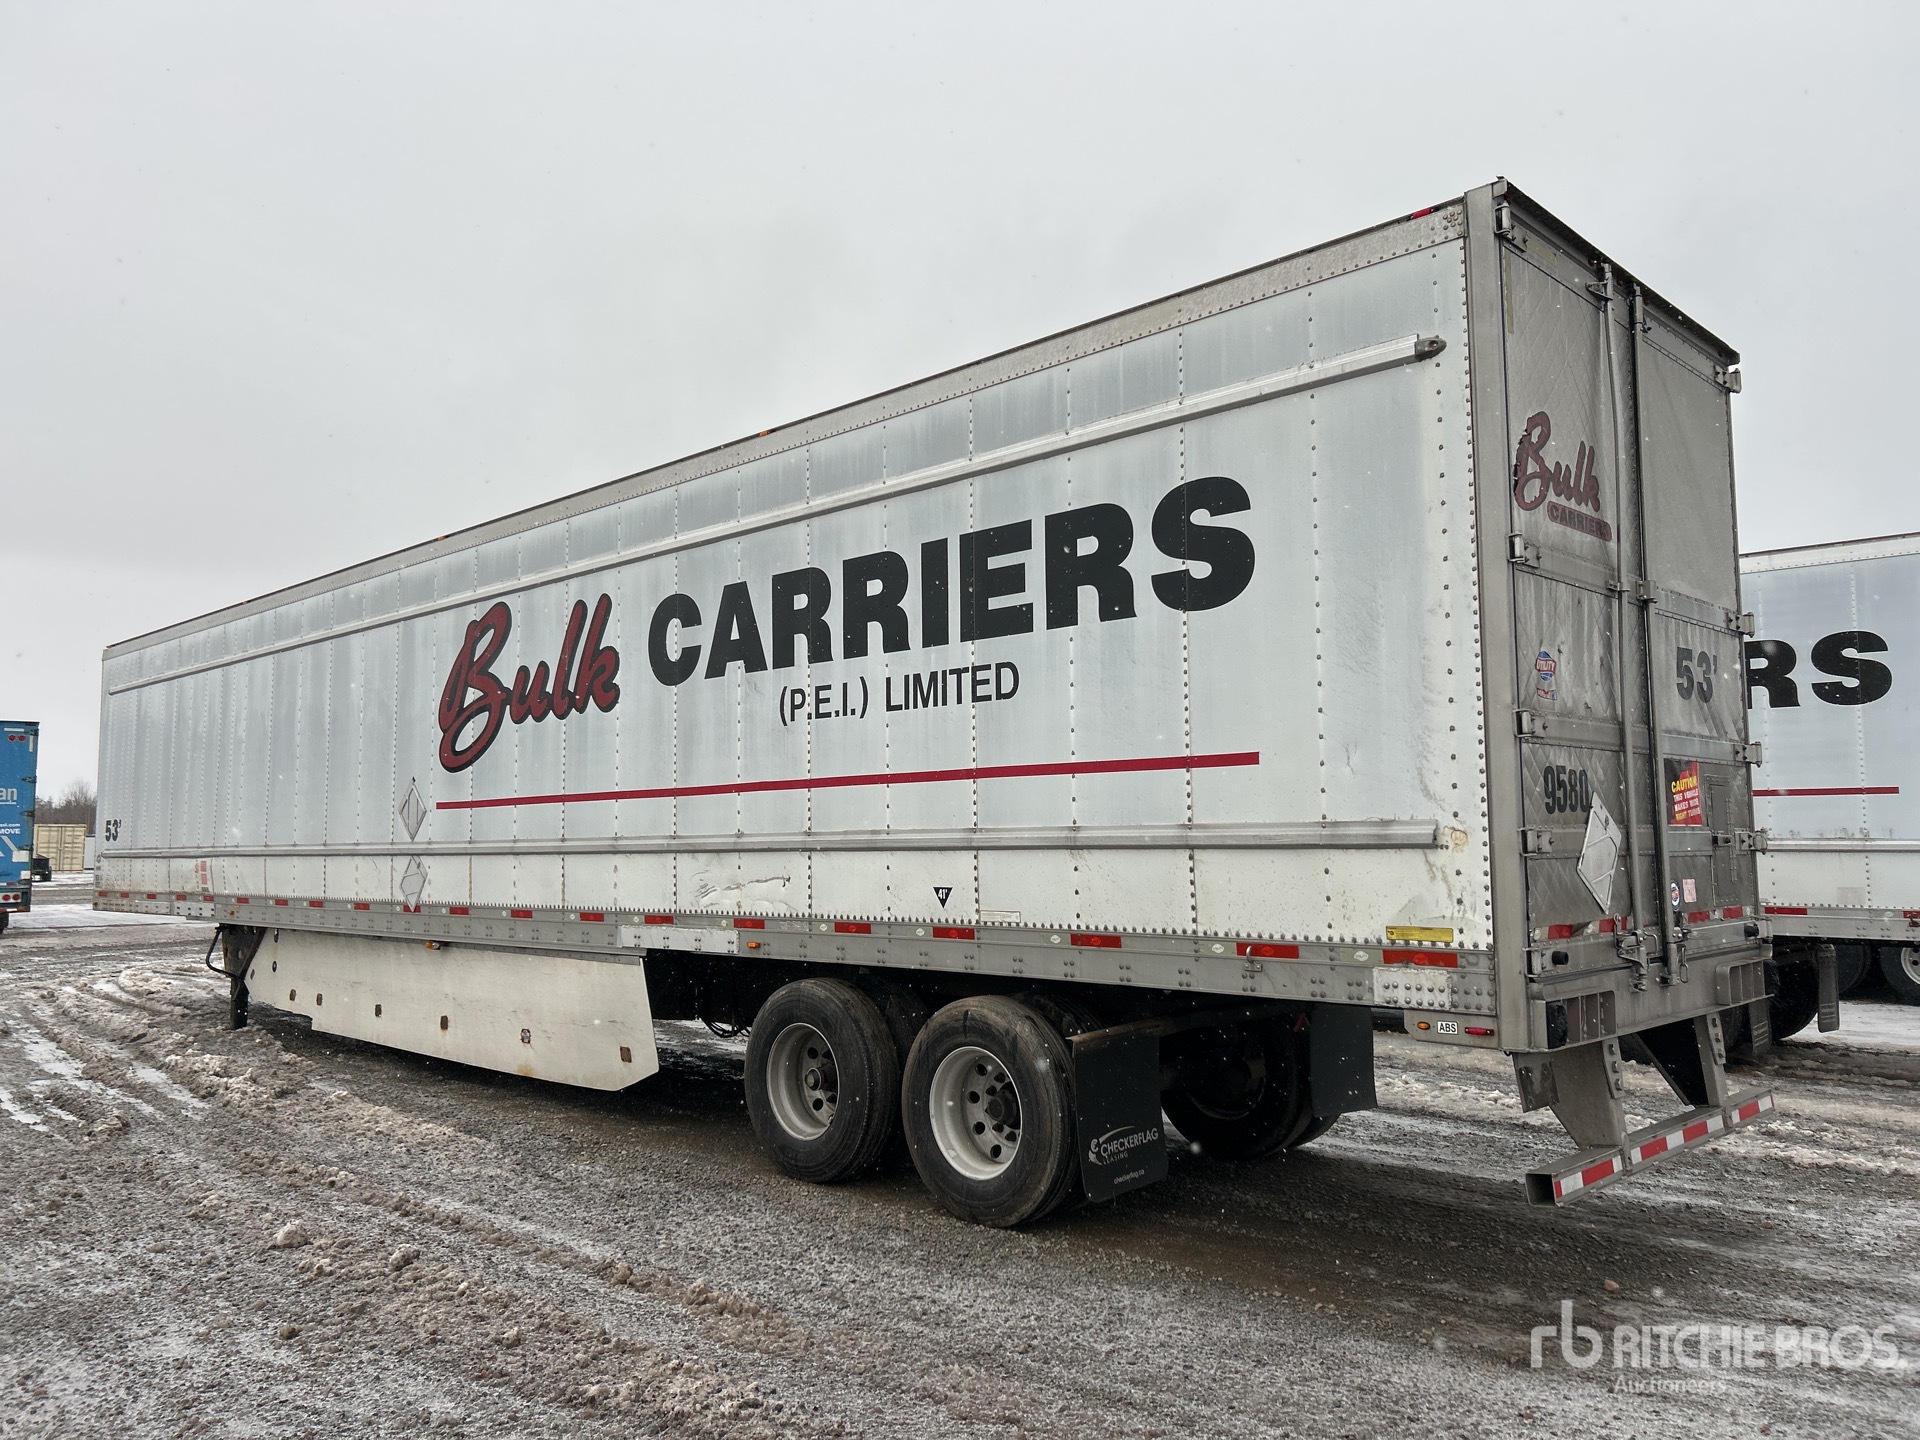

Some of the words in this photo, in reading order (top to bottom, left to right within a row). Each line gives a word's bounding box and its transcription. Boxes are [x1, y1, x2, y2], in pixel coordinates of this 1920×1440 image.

[1513, 411, 1600, 512] Bulk
[438, 593, 621, 773] Bulk
[648, 476, 1255, 687] CARRIERS
[779, 676, 868, 726] (P.E.I.)
[885, 661, 1020, 713] LIMITED
[1676, 646, 1717, 703] 53'
[1543, 765, 1590, 815] 9580
[105, 819, 122, 842] 53'
[1439, 1022, 1457, 1033] ABS
[1100, 1128, 1159, 1156] CHECKERFLAG
